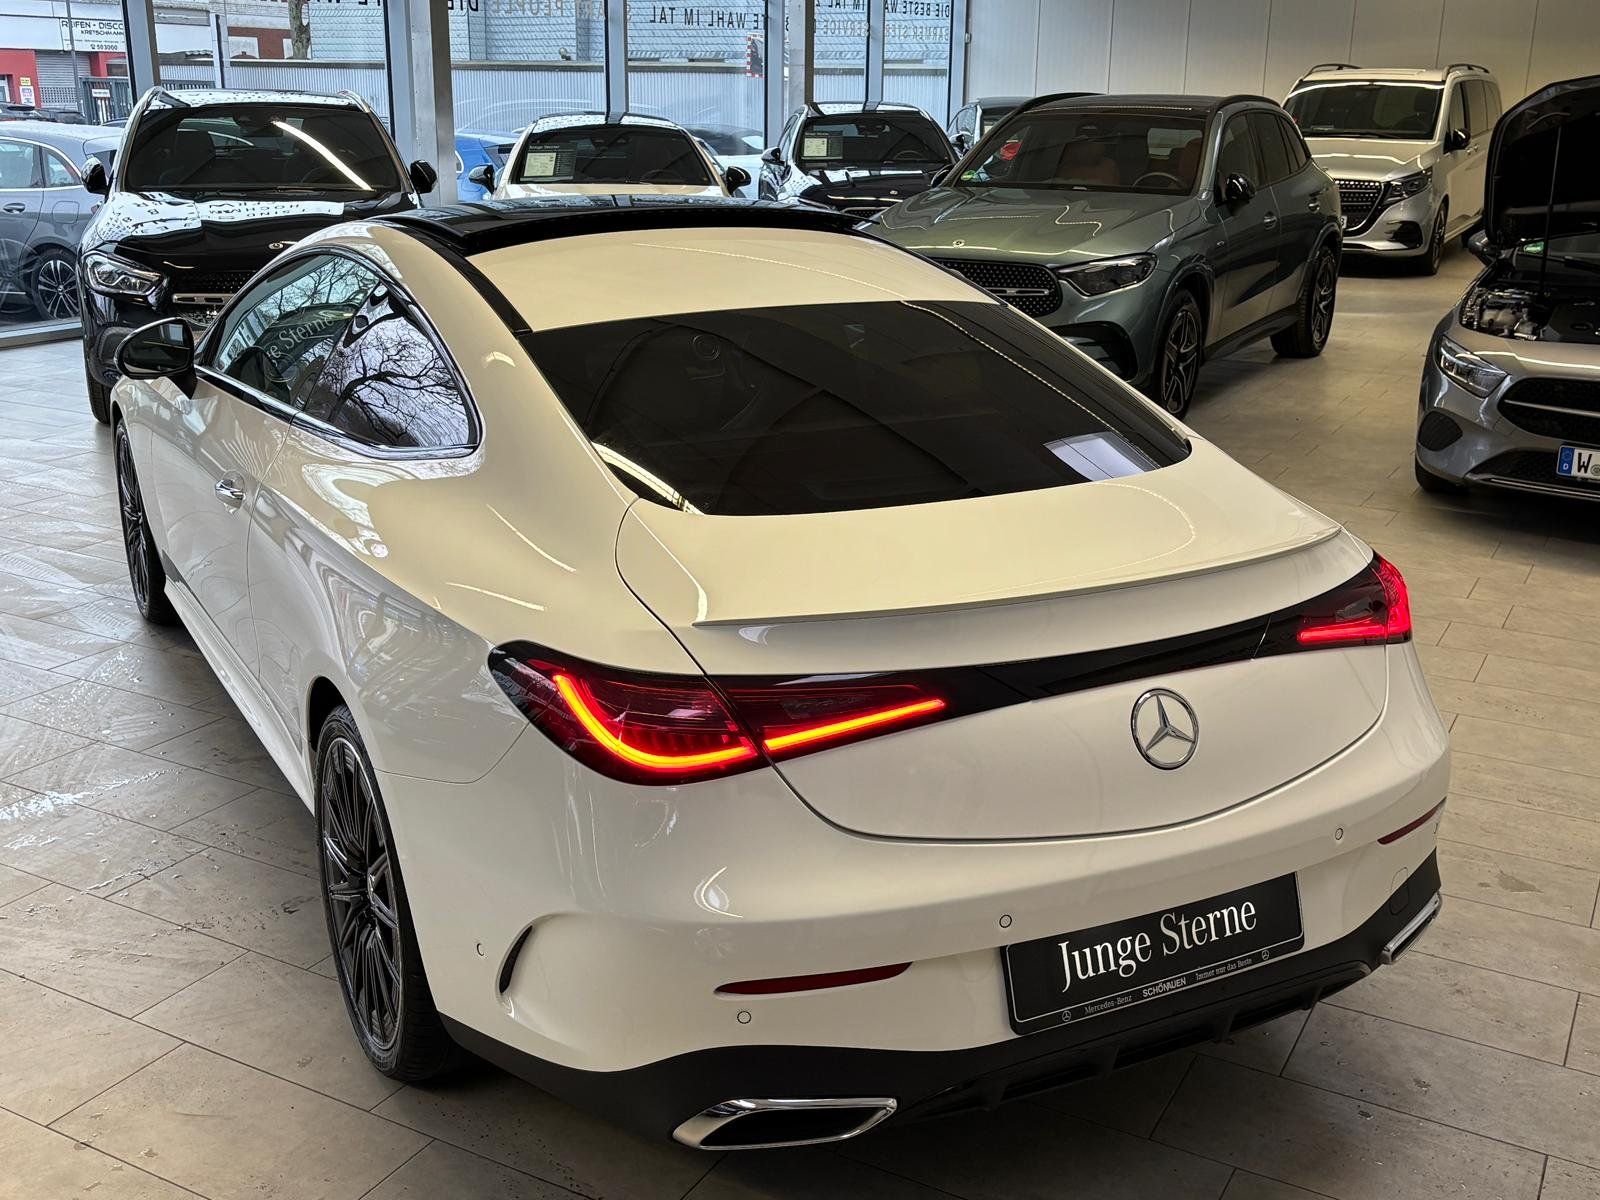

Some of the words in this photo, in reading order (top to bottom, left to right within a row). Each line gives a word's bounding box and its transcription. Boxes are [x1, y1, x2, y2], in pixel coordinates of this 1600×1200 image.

[1577, 452, 1593, 474] W
[1058, 932, 1152, 992] Junge
[1160, 901, 1257, 956] Sterne
[1084, 995, 1133, 1015] Mercedes-Benz
